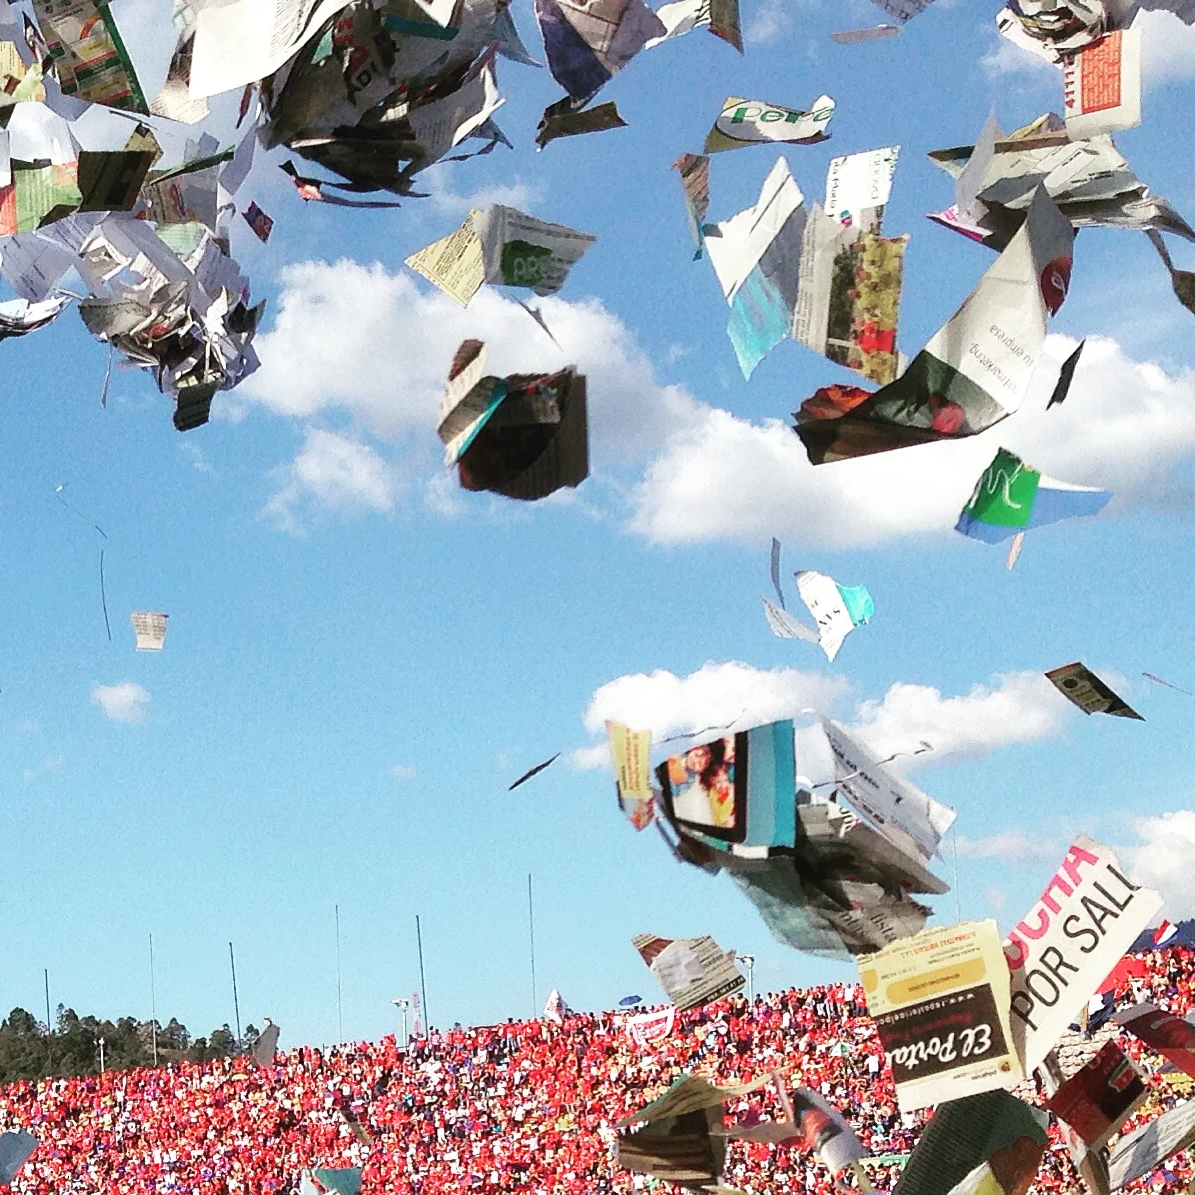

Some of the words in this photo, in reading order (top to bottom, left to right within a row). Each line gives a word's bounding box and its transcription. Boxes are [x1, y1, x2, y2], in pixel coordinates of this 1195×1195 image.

[986, 324, 1027, 358] empresa
[1011, 946, 1079, 1031] POR
[956, 1023, 996, 1058] El
